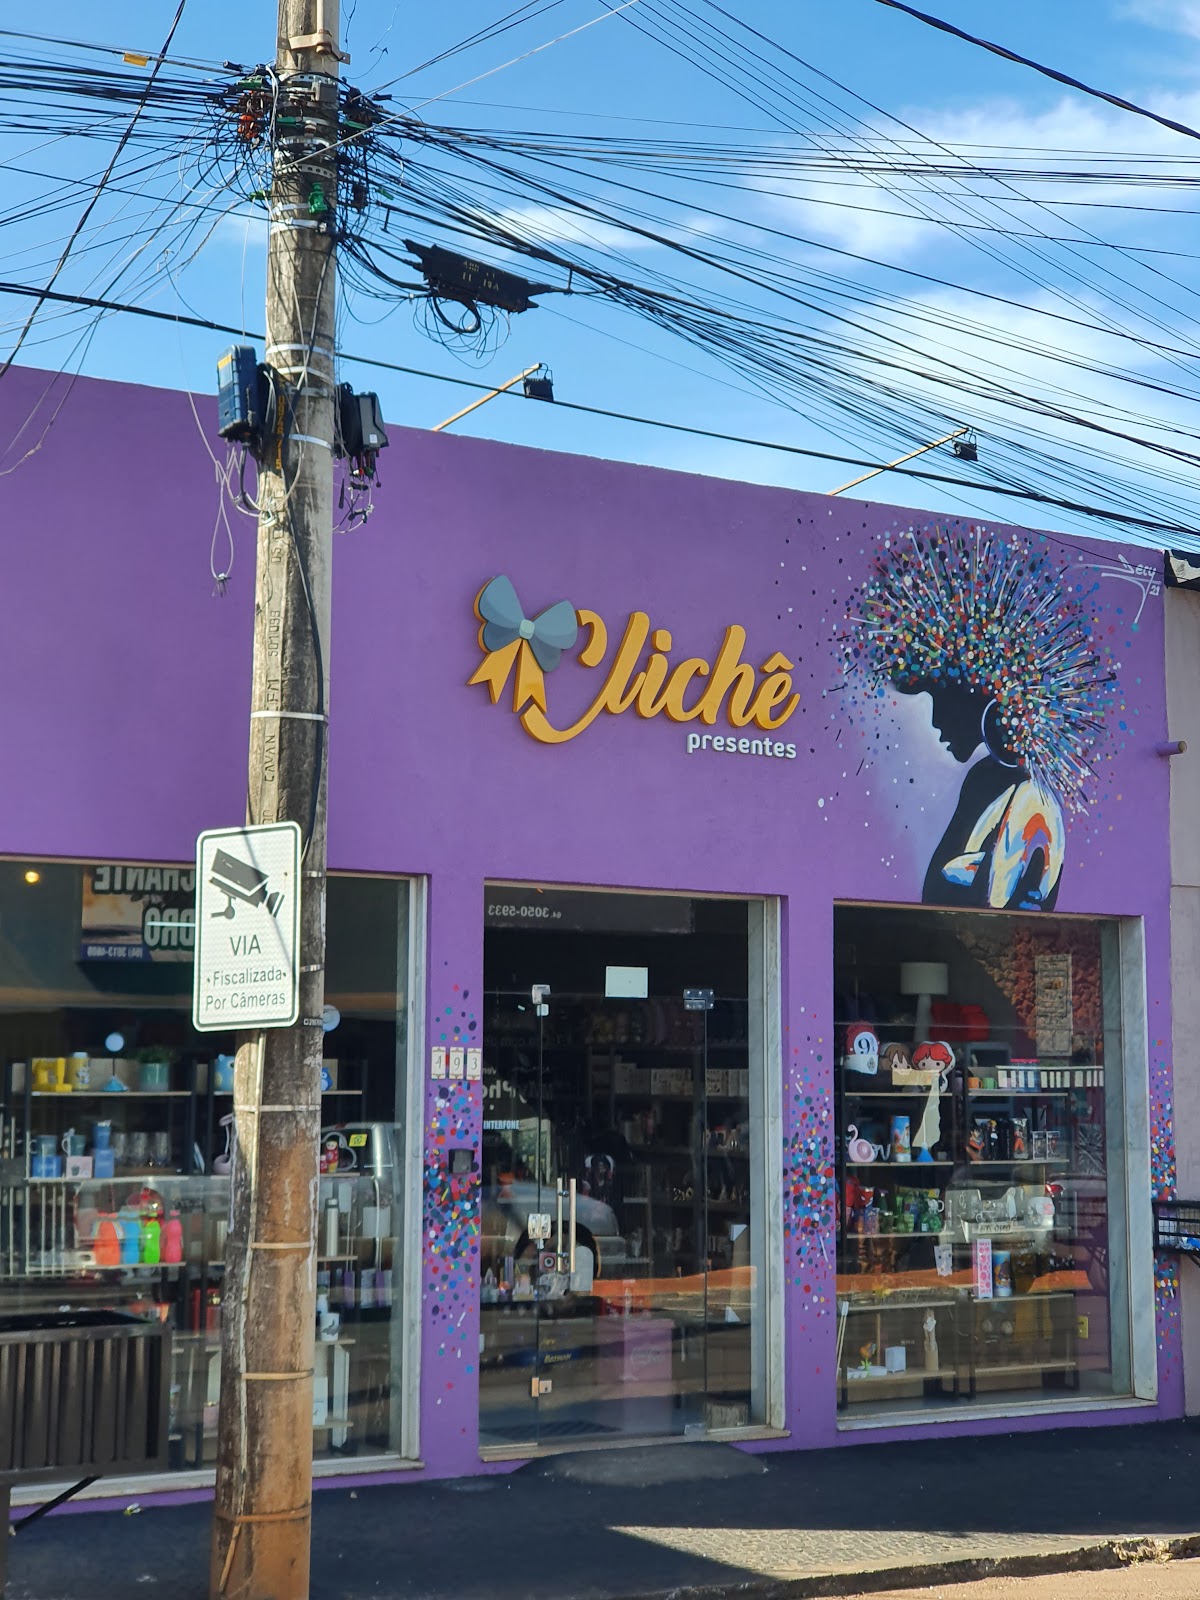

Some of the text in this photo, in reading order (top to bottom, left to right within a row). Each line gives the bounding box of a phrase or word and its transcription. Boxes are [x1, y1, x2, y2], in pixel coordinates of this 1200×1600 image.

[519, 608, 800, 744] Clichê
[687, 733, 797, 759] presentes
[229, 934, 262, 956] VIA
[213, 966, 282, 987] Fiscalizada
[206, 991, 286, 1012] Por Câmeras
[483, 1120, 520, 1130] INTERFONE
